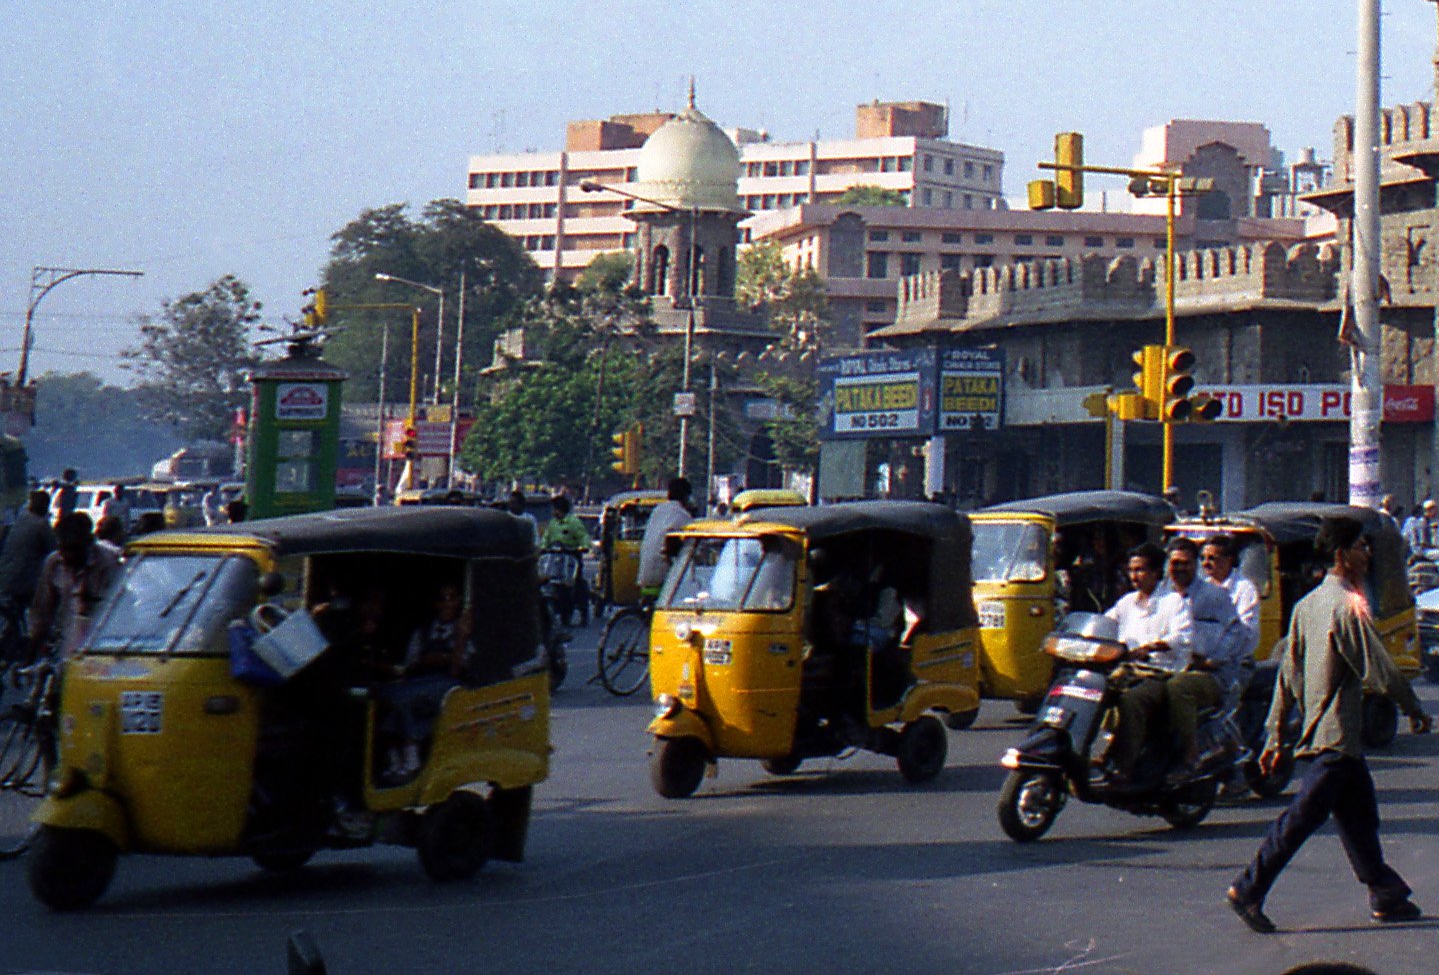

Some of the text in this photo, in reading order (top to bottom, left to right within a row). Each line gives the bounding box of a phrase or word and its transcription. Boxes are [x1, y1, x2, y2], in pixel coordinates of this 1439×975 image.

[943, 377, 998, 393] PATAKA
[837, 381, 917, 412] PATAKA BEEDI
[943, 396, 996, 411] BEEDI
[1258, 391, 1304, 417] ISD
[868, 413, 899, 427] 502
[945, 415, 968, 427] NO
